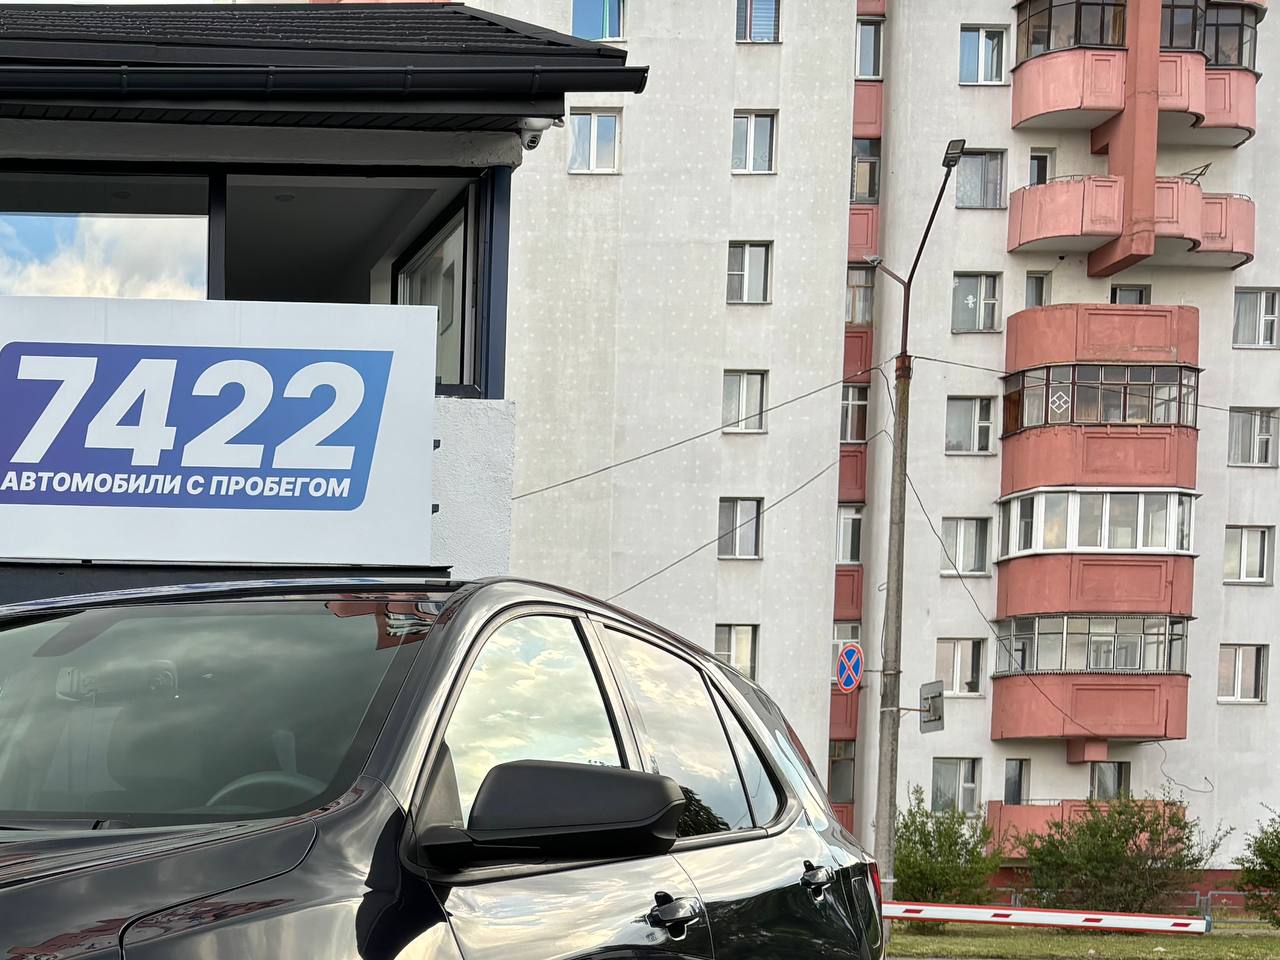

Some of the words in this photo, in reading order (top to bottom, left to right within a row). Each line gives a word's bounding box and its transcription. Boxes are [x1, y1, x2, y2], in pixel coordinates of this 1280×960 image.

[9, 355, 365, 470] 7422
[0, 470, 182, 495] АВТОМОБИЛИ
[186, 474, 205, 495] С
[209, 474, 352, 498] ПРОБЕГОМ
